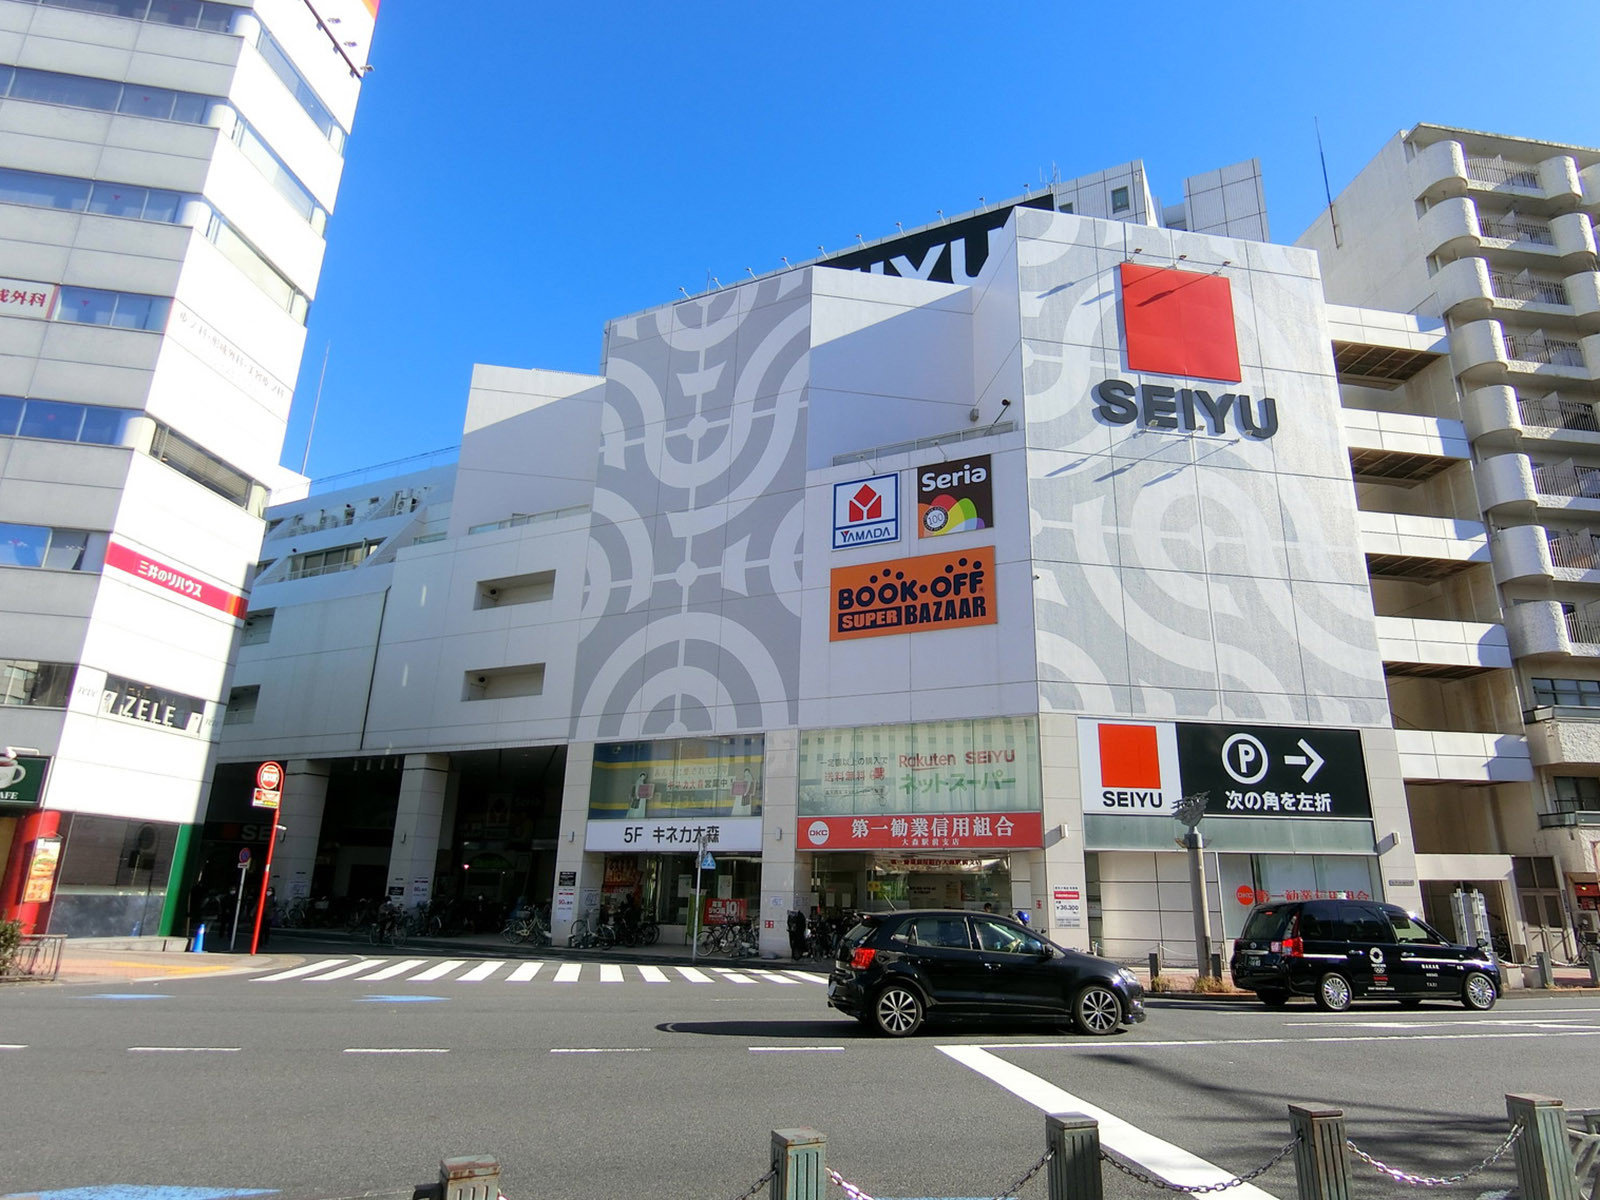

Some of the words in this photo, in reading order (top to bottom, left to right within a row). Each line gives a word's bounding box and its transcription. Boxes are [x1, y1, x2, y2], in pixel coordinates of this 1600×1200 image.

[1097, 379, 1279, 439] SEIYU
[921, 464, 987, 492] Seria
[928, 512, 944, 525] 100
[840, 527, 891, 543] YAMADA
[137, 560, 203, 598] 三井のリハウス
[841, 610, 898, 630] SUPER
[904, 596, 986, 625] BAZAAR
[122, 695, 177, 727] ZELE
[898, 752, 957, 771] Rakuten
[965, 749, 1015, 764] SEIYU
[1103, 790, 1162, 808] SEIYU
[1225, 790, 1332, 812] 次の角を左折
[623, 827, 643, 843] 5F
[653, 825, 720, 843] キネカ大森
[851, 816, 1014, 839] 第一勧業信用組合
[901, 838, 960, 846] 大森駅前支店
